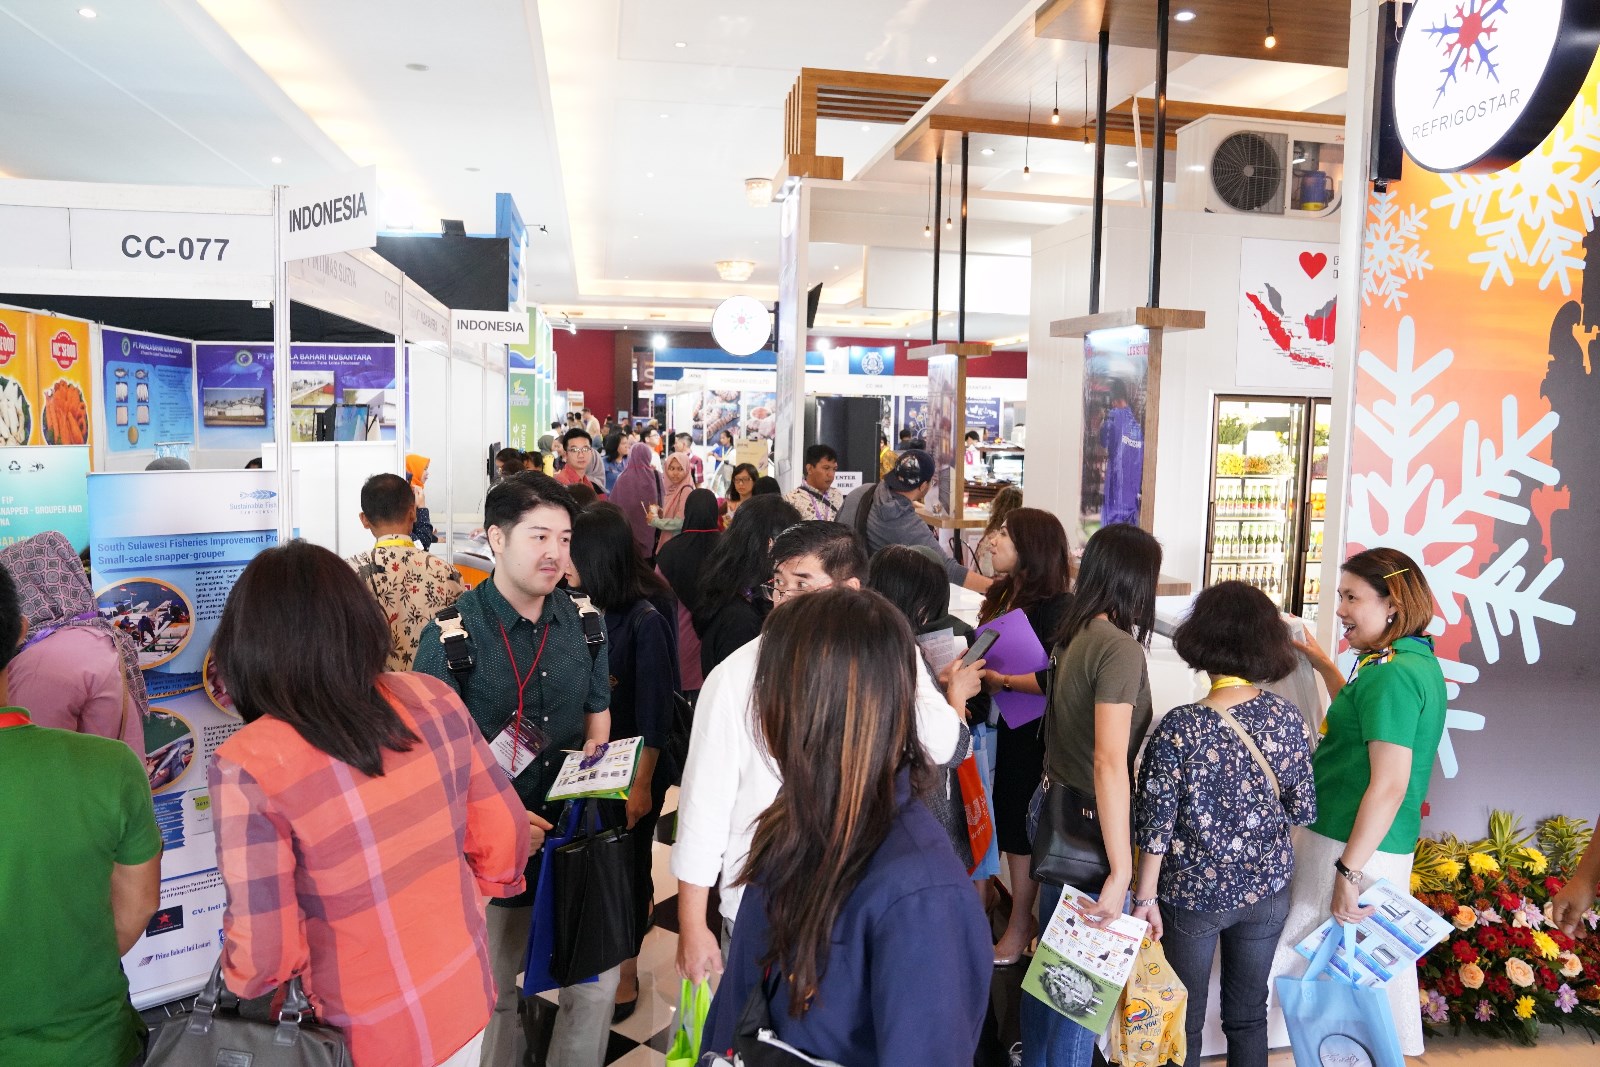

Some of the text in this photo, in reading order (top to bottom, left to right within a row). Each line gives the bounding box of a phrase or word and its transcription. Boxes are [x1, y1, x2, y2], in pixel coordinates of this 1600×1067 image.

[1412, 88, 1520, 141] REFRIGOSTAR
[289, 192, 368, 233] INDONESIA
[121, 234, 231, 263] CC-077
[457, 319, 525, 333] INDONESIA
[300, 353, 327, 361] BAHARI
[328, 354, 372, 362] NUSANTARA
[35, 506, 67, 515] GROUPER
[68, 505, 83, 513] AND
[97, 543, 125, 553] South
[127, 540, 168, 551] Sulawesi
[169, 537, 208, 549] Fisheries
[210, 534, 264, 547] Improvement
[98, 550, 226, 565] Small-scale snapper-grouper
[191, 908, 206, 916] CV.
[1143, 1020, 1157, 1030] you
